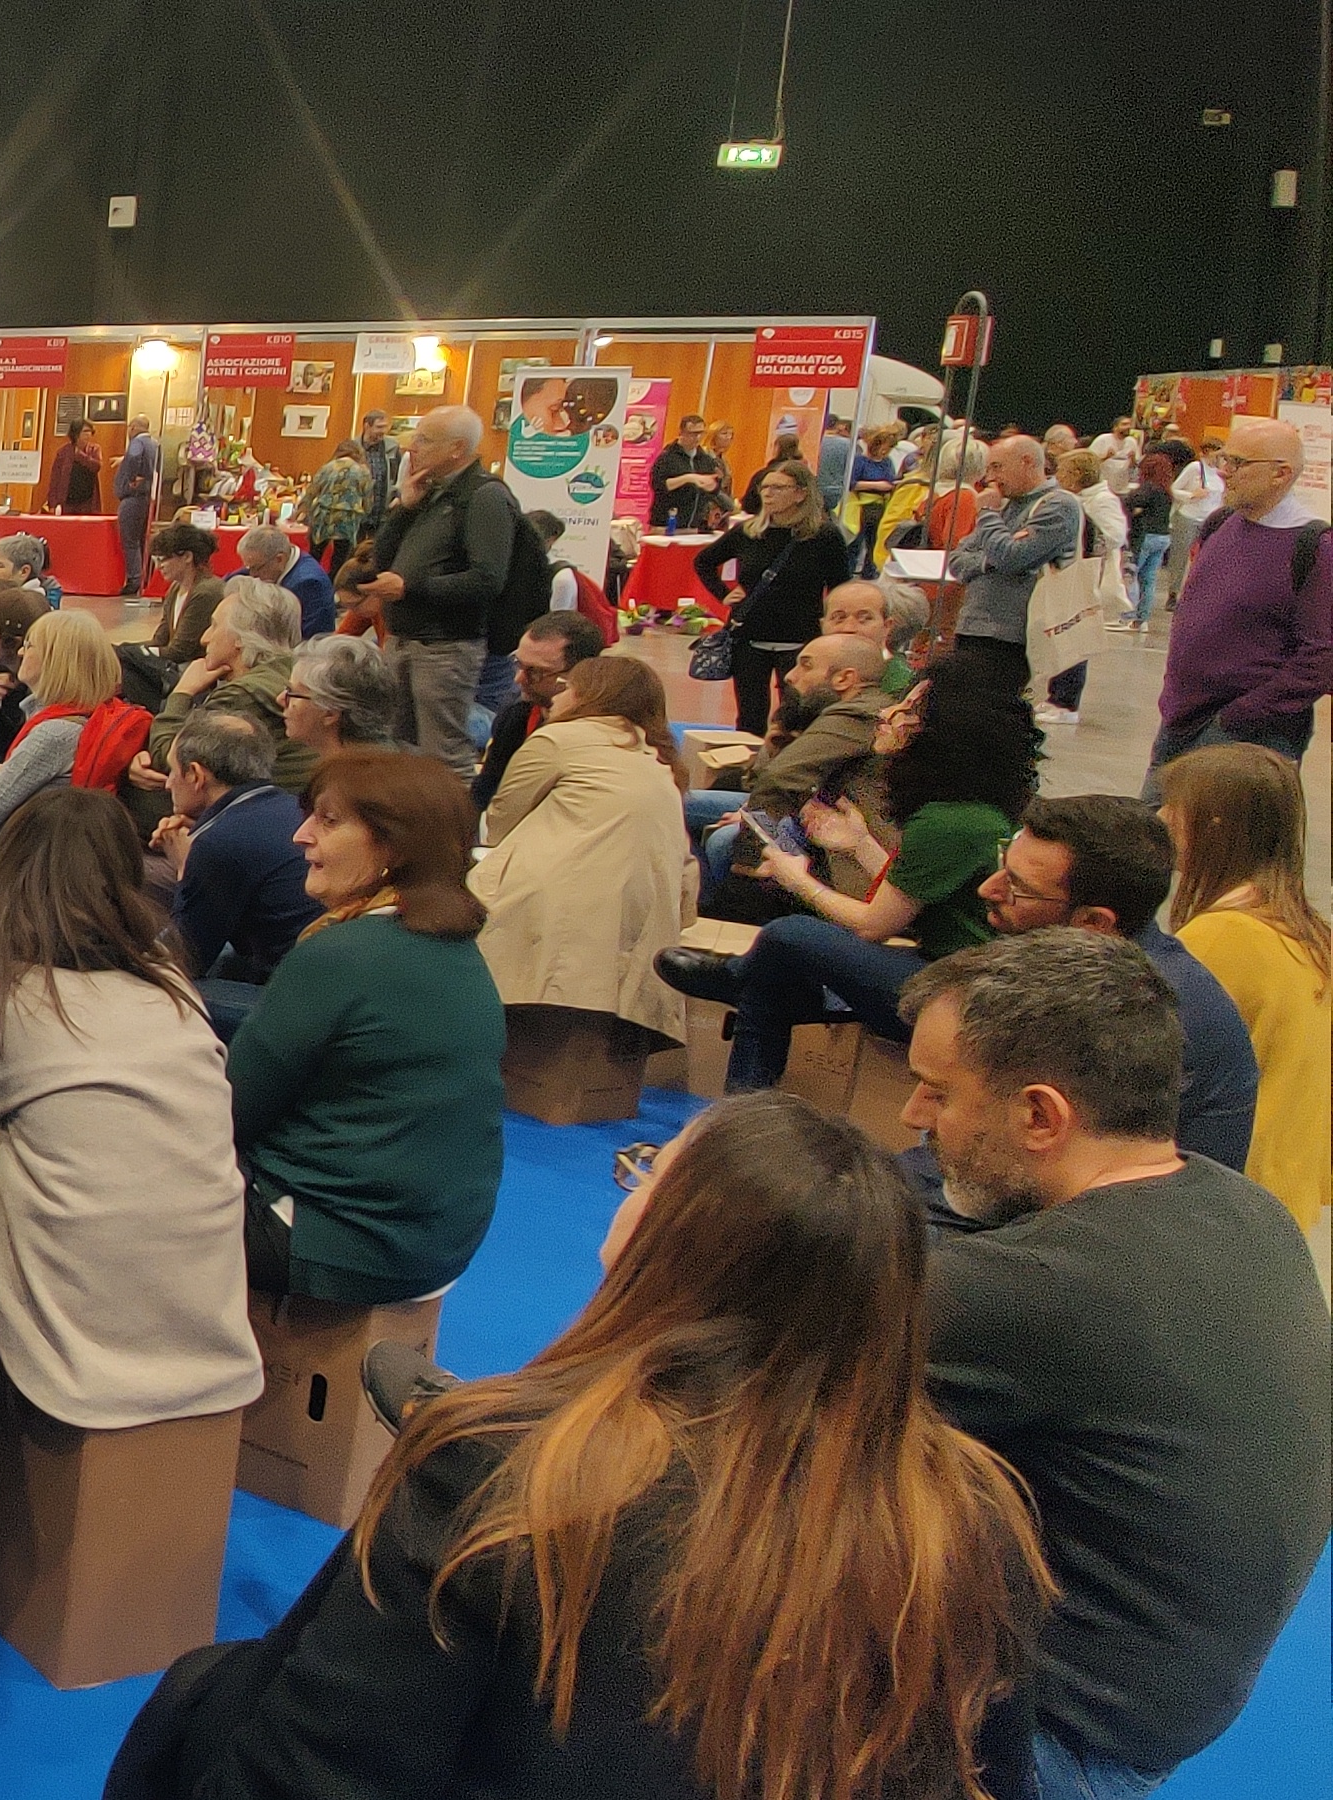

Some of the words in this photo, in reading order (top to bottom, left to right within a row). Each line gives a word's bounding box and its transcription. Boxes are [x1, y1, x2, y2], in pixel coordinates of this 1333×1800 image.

[207, 357, 282, 367] ASSOCIAZIONE
[756, 354, 844, 364] INFORMATICA
[206, 367, 237, 377] OLTRE
[245, 367, 287, 376] CONFINI
[755, 365, 816, 375] SOLIDALE
[817, 365, 847, 375] ODV
